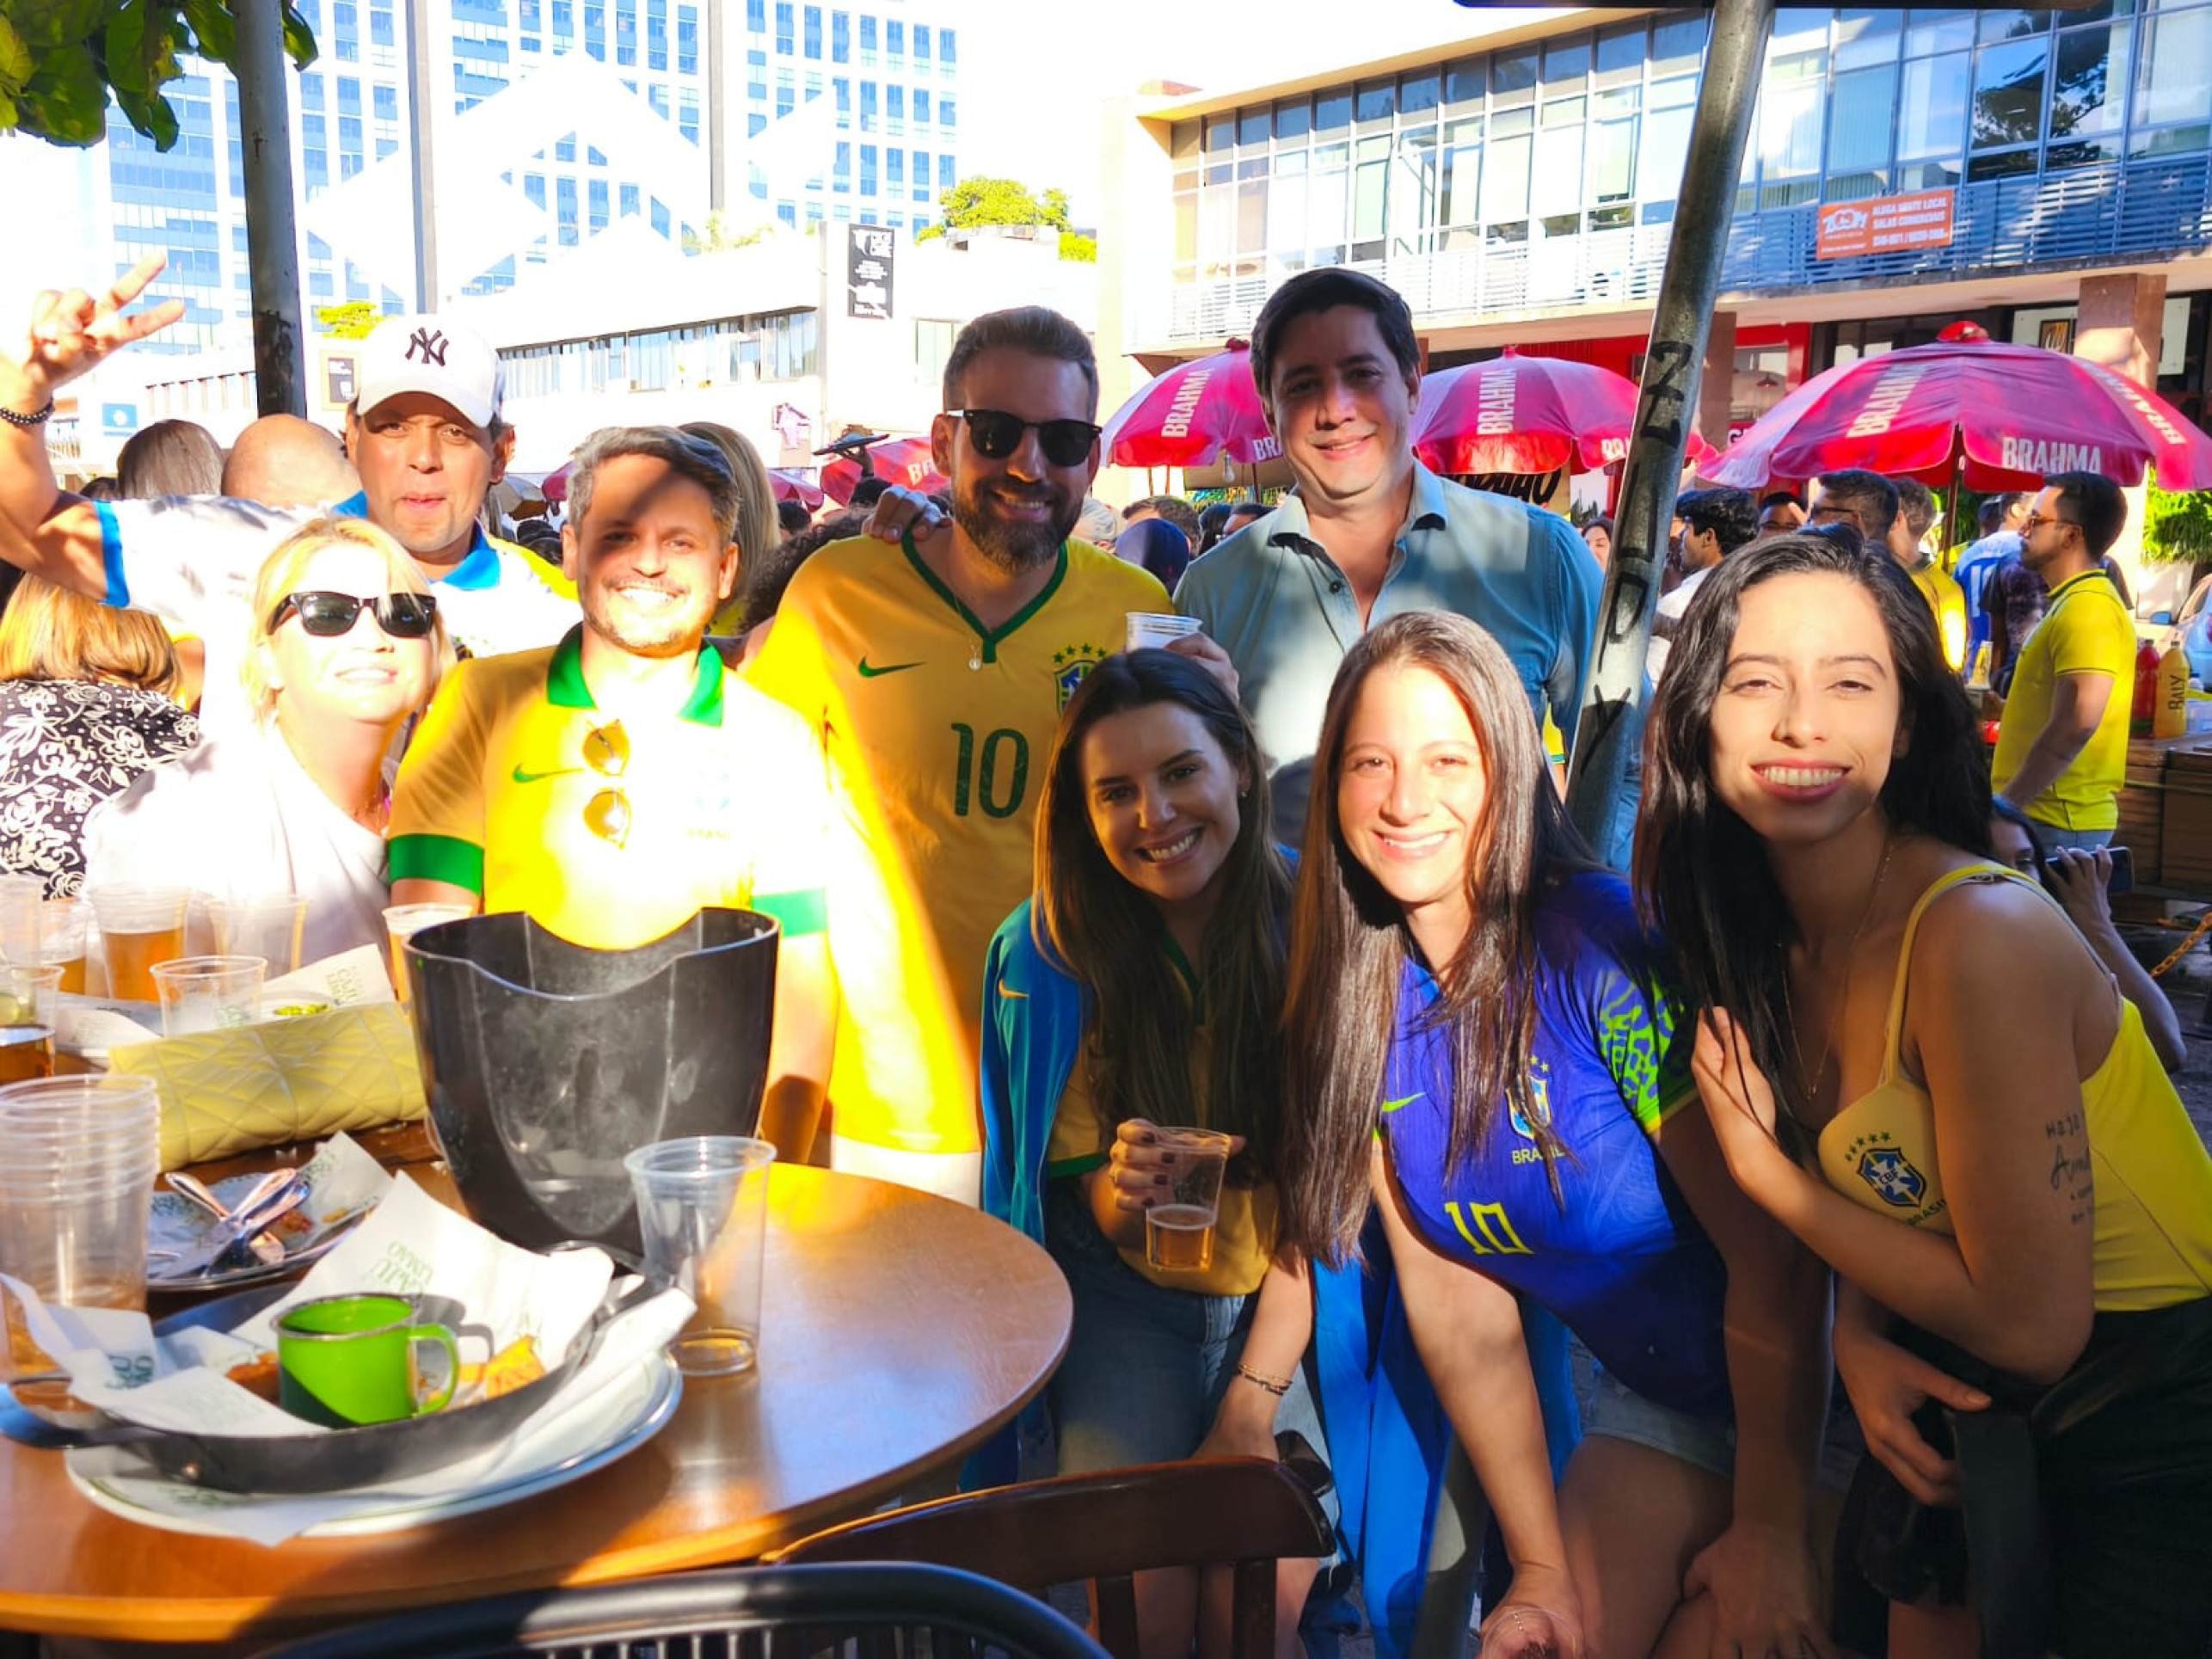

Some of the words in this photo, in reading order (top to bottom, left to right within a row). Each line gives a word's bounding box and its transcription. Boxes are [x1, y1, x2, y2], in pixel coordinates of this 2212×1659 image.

[405, 327, 449, 366] NY
[1160, 367, 1214, 439] BRAHMA
[1476, 367, 1517, 435] BRAHMA
[2001, 436, 2102, 474] BRAHMA
[950, 722, 1029, 820] 10
[1511, 1143, 1566, 1165] BRAIL
[1444, 1201, 1536, 1256] 10
